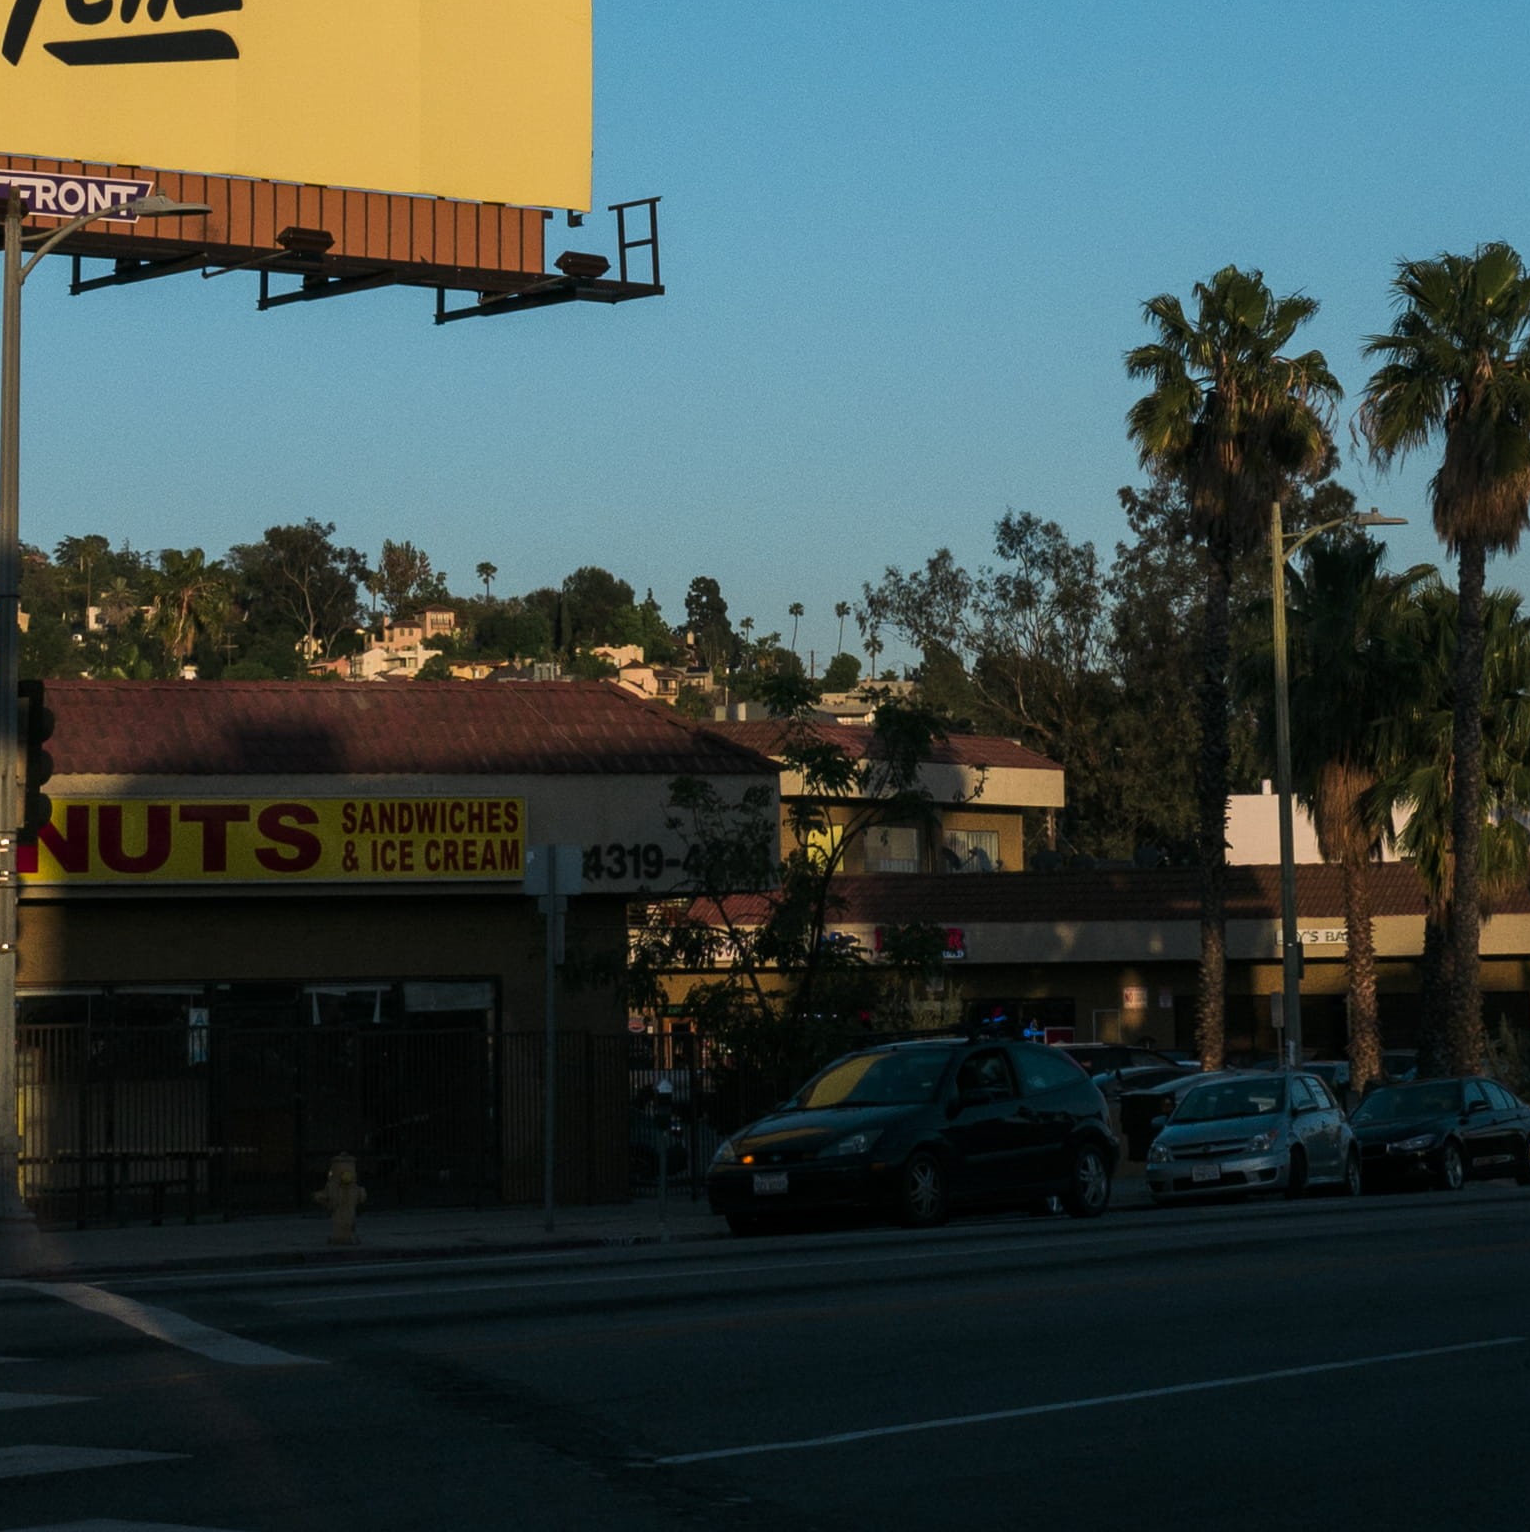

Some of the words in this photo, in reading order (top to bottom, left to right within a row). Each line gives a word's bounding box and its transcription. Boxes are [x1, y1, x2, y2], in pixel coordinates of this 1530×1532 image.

[341, 801, 519, 835] SANDWICHES
[341, 839, 359, 873] &
[371, 839, 417, 873] ICE
[424, 839, 519, 872] CREAM
